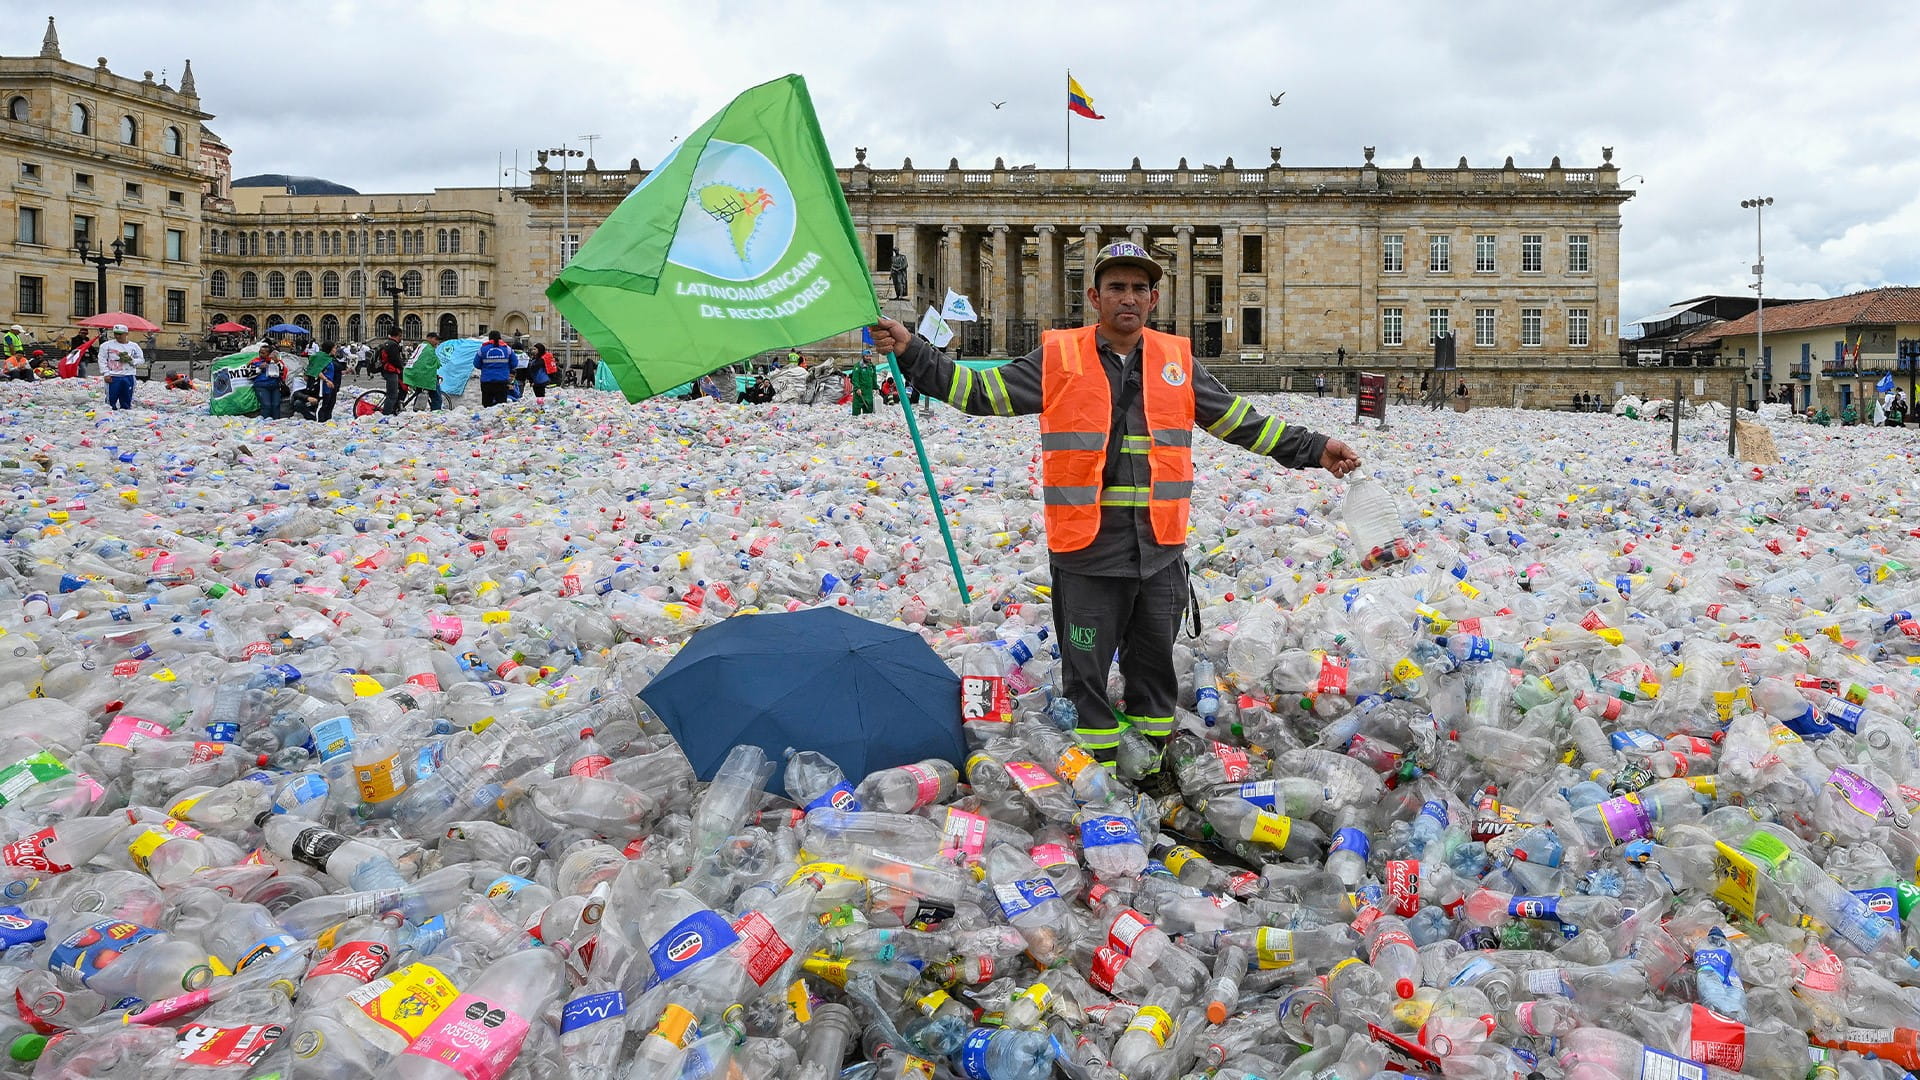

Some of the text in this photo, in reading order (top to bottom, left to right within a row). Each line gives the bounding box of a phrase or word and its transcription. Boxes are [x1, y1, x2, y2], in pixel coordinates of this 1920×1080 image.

[676, 251, 823, 302] LATINOAMERICANA
[700, 276, 831, 321] DE RECICLADORES
[1069, 622, 1097, 646] UAESP
[963, 679, 984, 719] BIG
[669, 937, 701, 958] PEPSI
[201, 1031, 225, 1052] COLA
